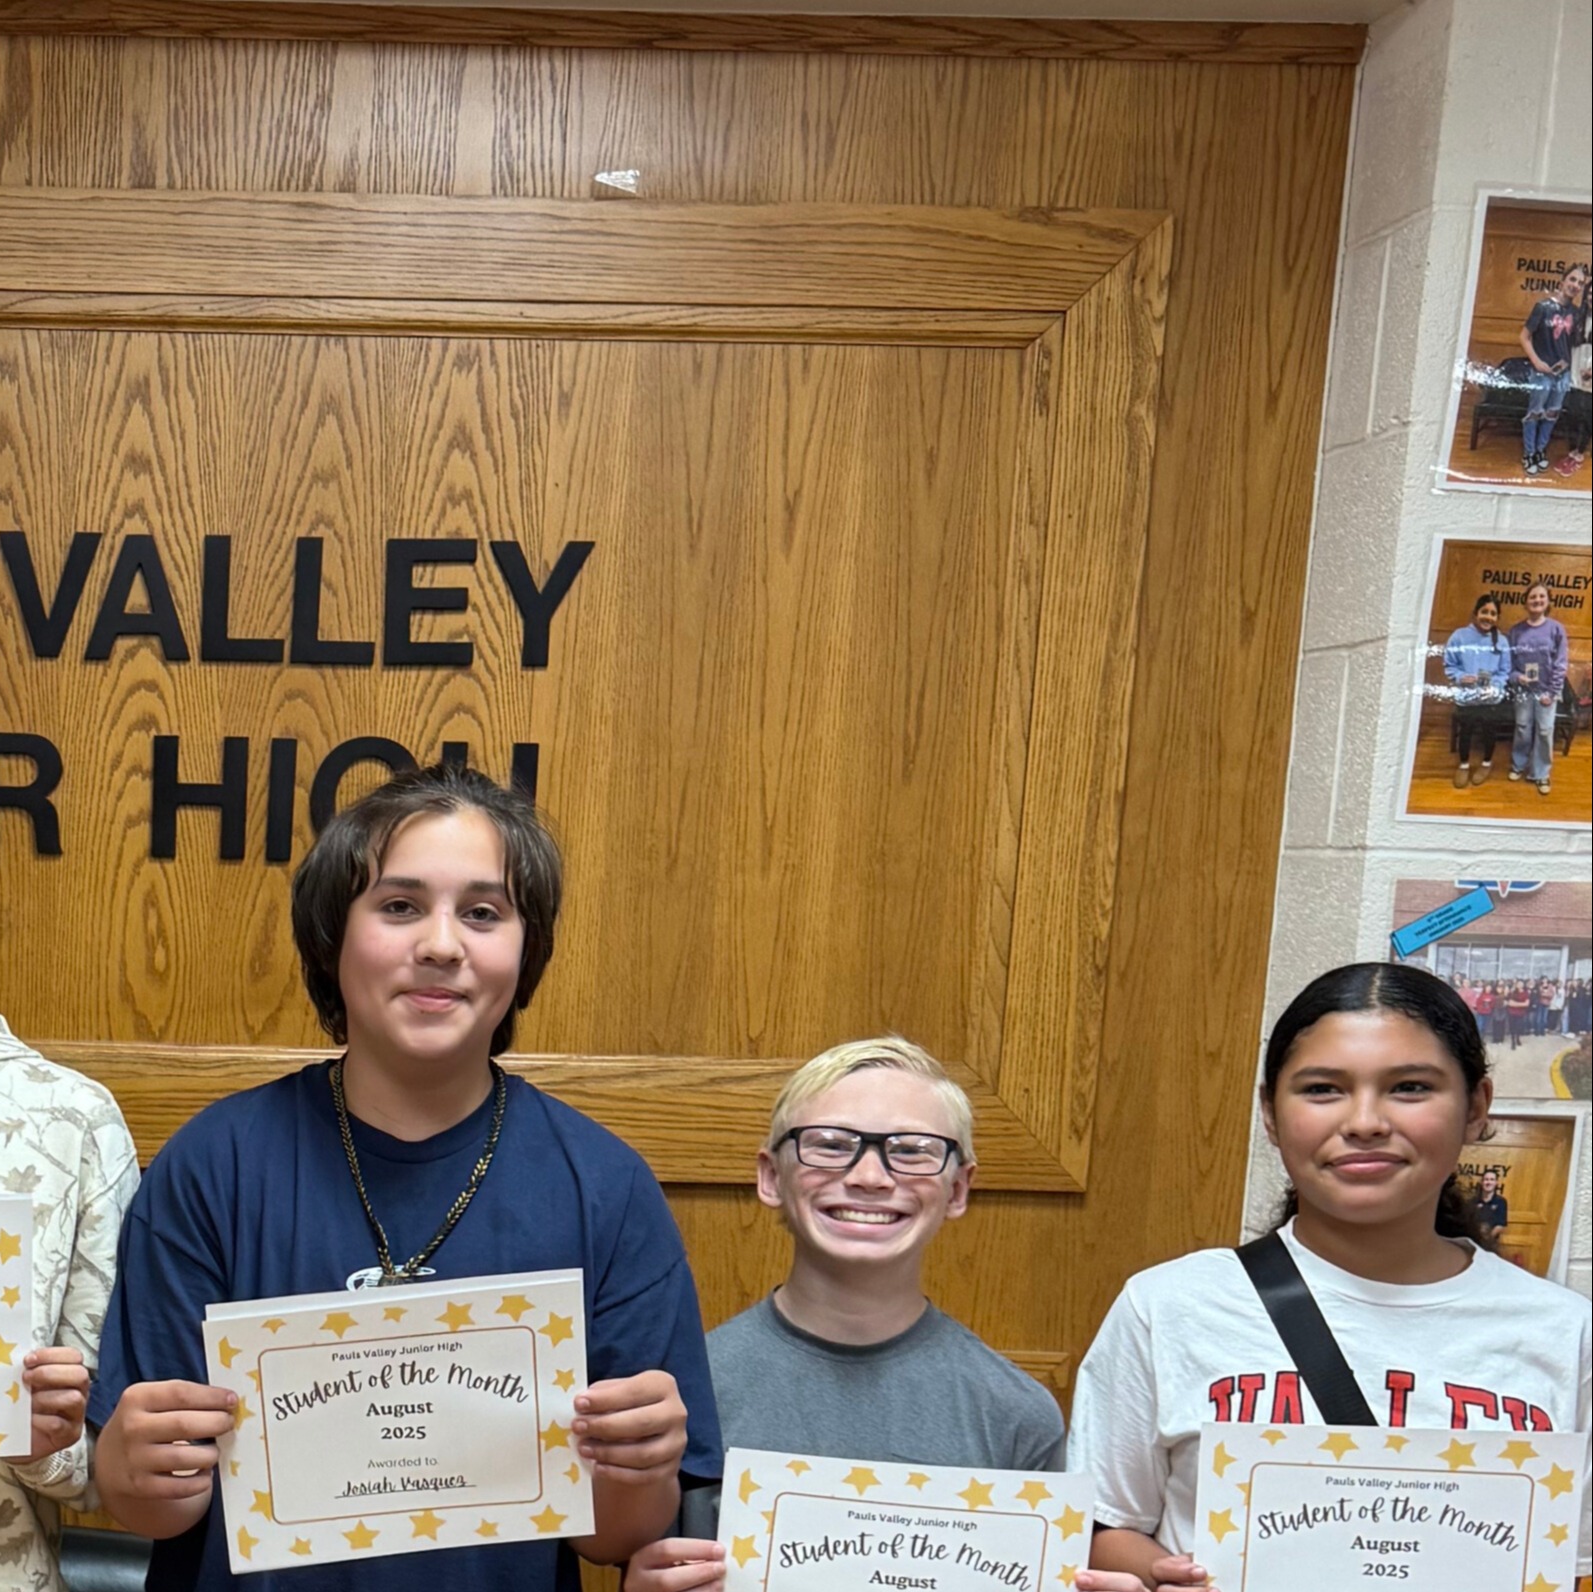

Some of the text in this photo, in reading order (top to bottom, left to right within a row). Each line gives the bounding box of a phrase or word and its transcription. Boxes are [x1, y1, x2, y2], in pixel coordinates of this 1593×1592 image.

[1517, 258, 1565, 274] PAULS
[1482, 569, 1531, 585] PAULS
[0, 529, 595, 669] VALLEY
[331, 1341, 463, 1362] Pauls Valley Junior High
[272, 1361, 530, 1421] Student of the Month
[365, 1401, 434, 1418] August
[380, 1425, 427, 1440] 2025
[367, 1456, 421, 1470] Awarded
[342, 1477, 397, 1497] Josiah
[1325, 1476, 1460, 1492] Pauls Valley Junior High
[847, 1510, 978, 1532] Pauls Valley Junior High
[1257, 1496, 1520, 1552] Student of the Month
[1350, 1535, 1421, 1554] August
[779, 1532, 1031, 1592] Student of the Month
[1362, 1563, 1410, 1579] 2025
[869, 1569, 938, 1591] August
